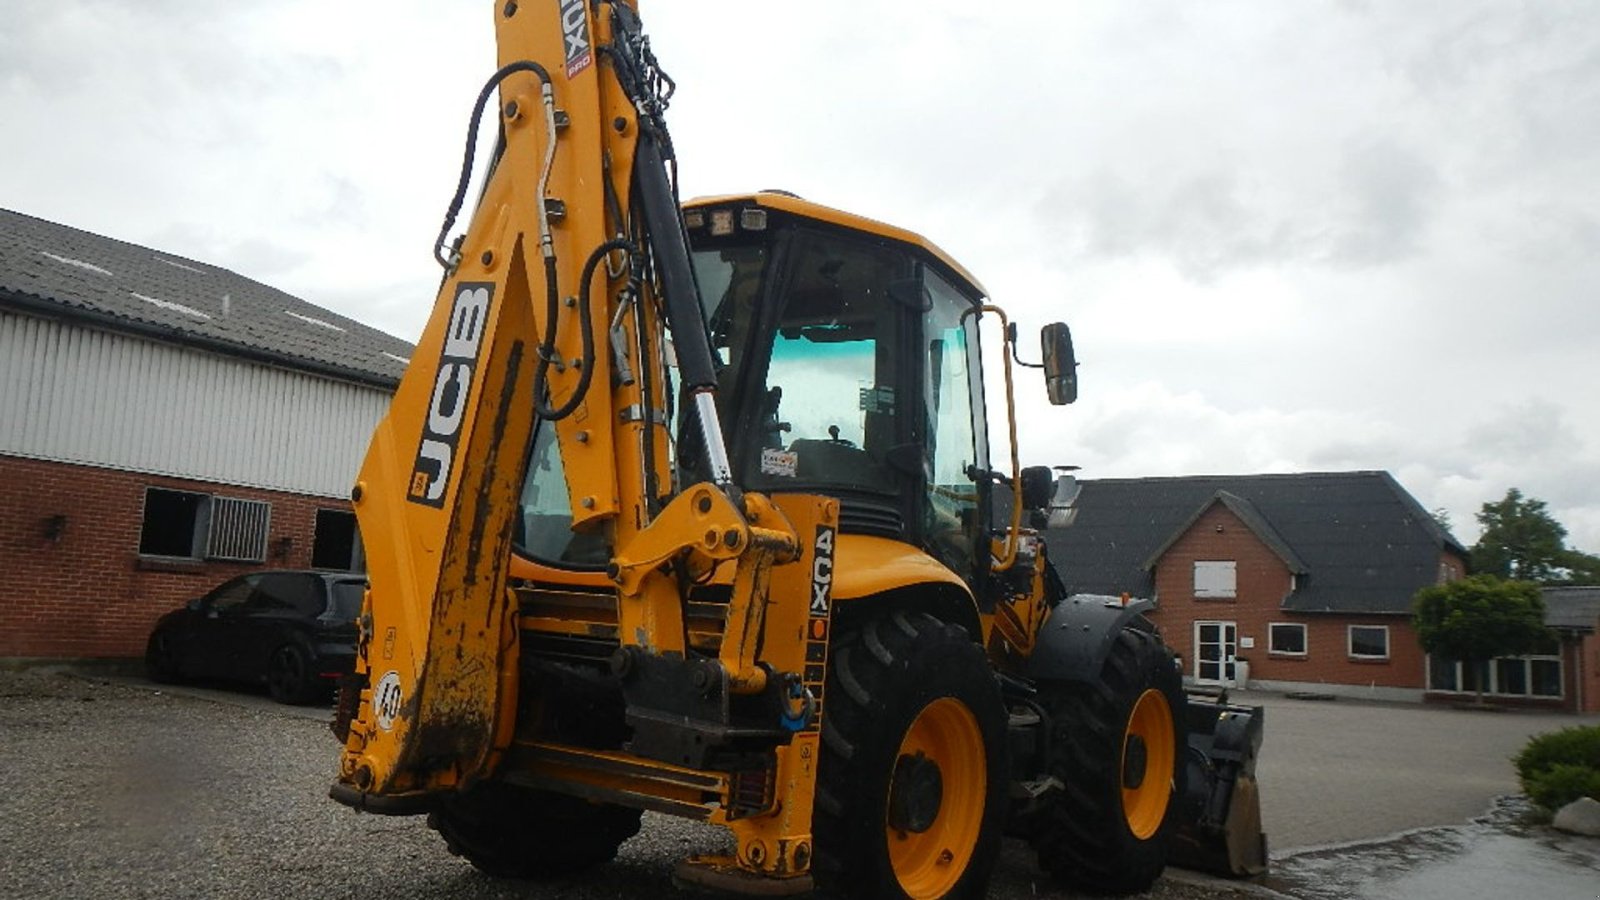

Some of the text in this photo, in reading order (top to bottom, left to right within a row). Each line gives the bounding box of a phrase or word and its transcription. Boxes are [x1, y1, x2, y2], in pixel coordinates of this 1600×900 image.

[568, 55, 591, 78] PRO
[419, 287, 489, 500] JCB
[811, 529, 832, 612] 4CX
